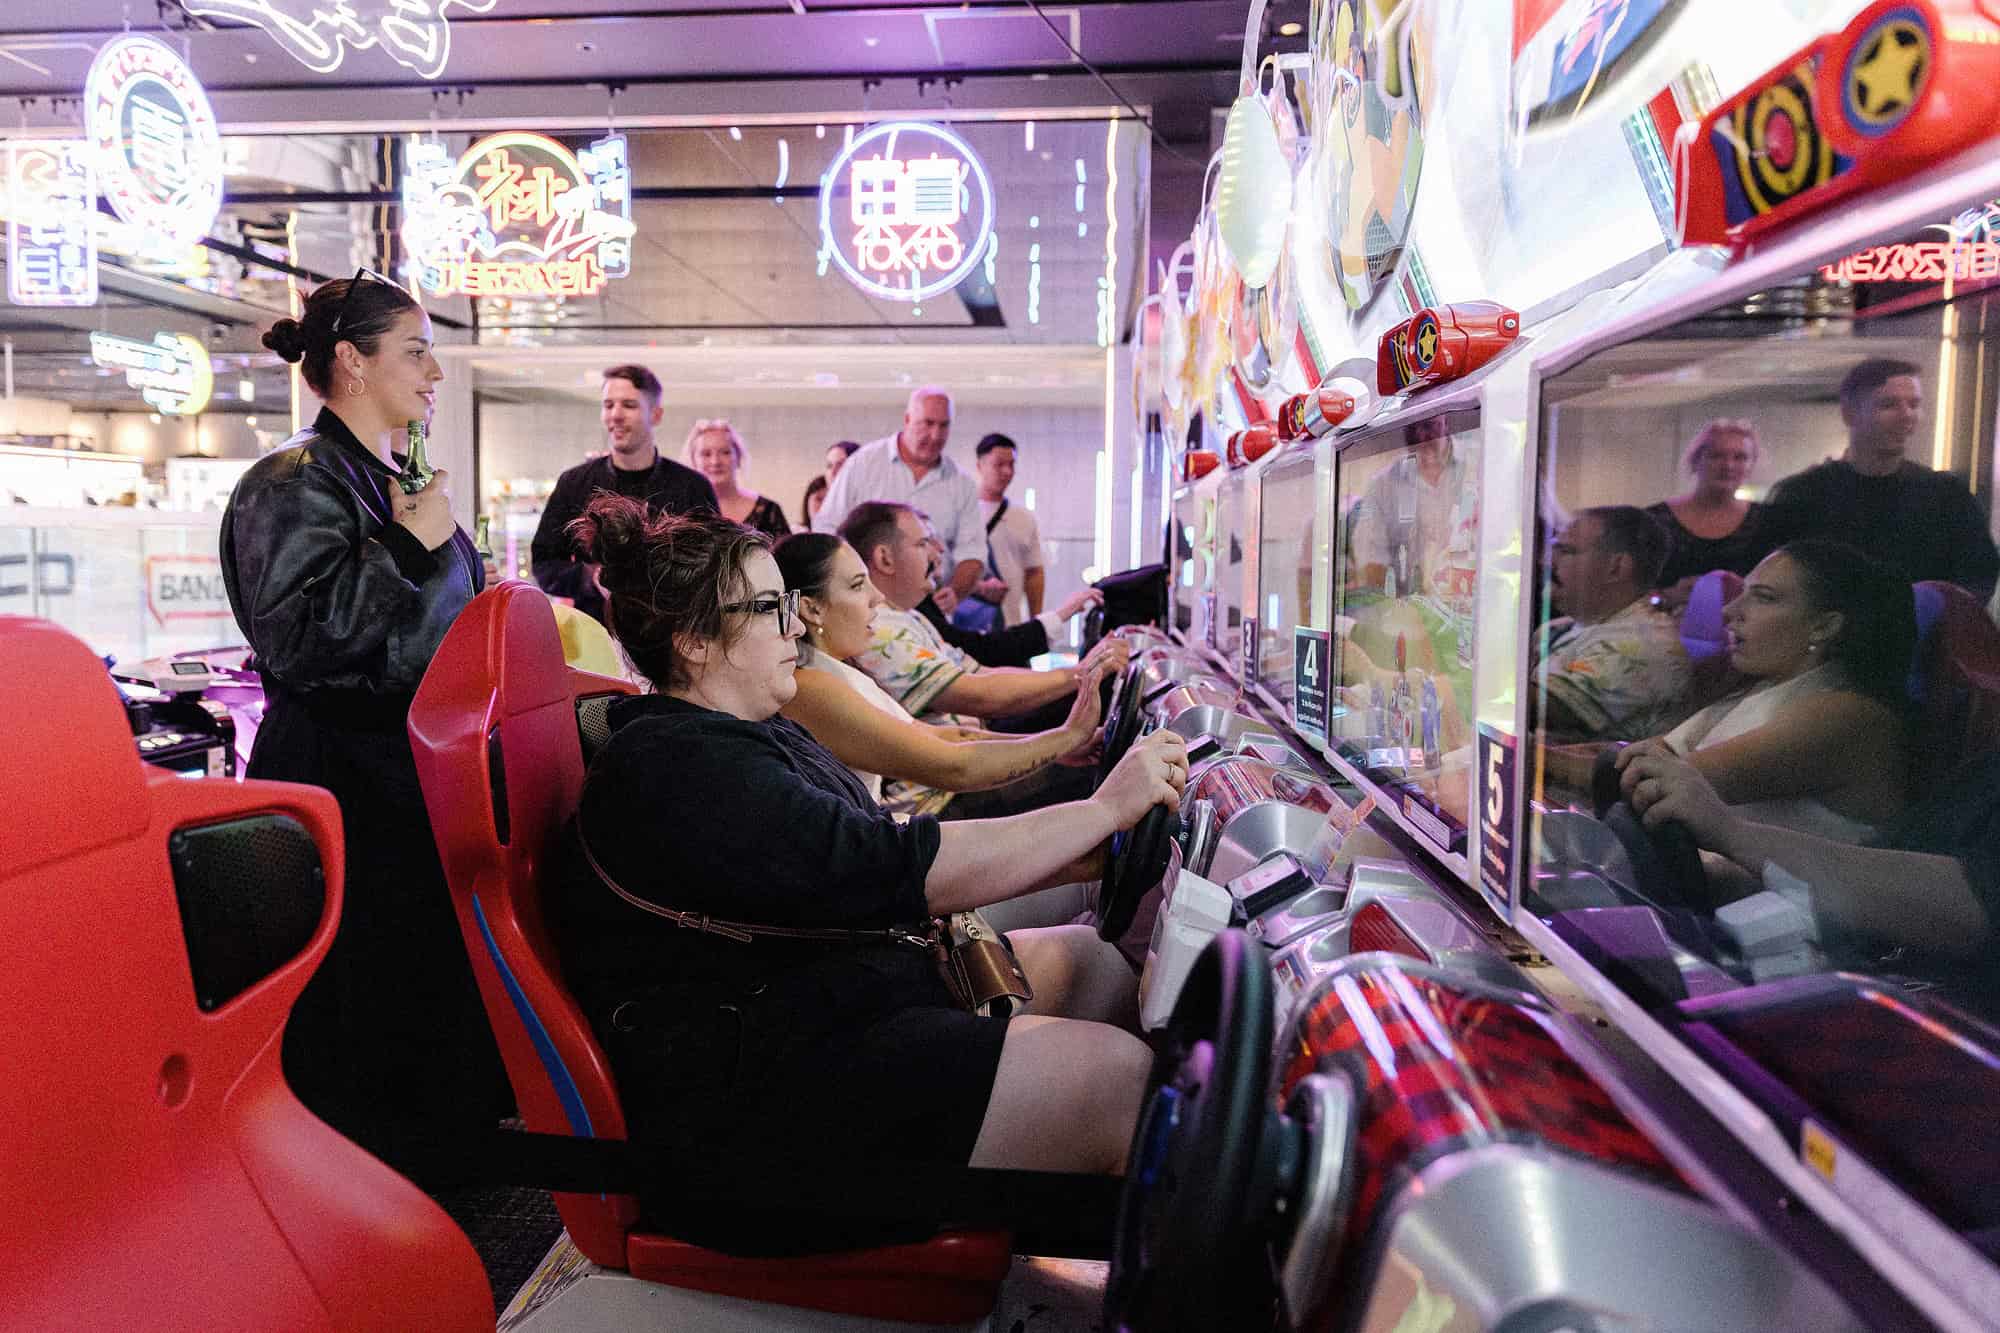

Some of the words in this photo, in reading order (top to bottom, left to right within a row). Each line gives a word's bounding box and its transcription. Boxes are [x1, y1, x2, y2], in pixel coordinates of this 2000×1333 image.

[853, 238, 962, 270] TOKYO
[1244, 623, 1252, 657] 3
[1303, 639, 1319, 686] 4
[1487, 741, 1504, 826] 5
